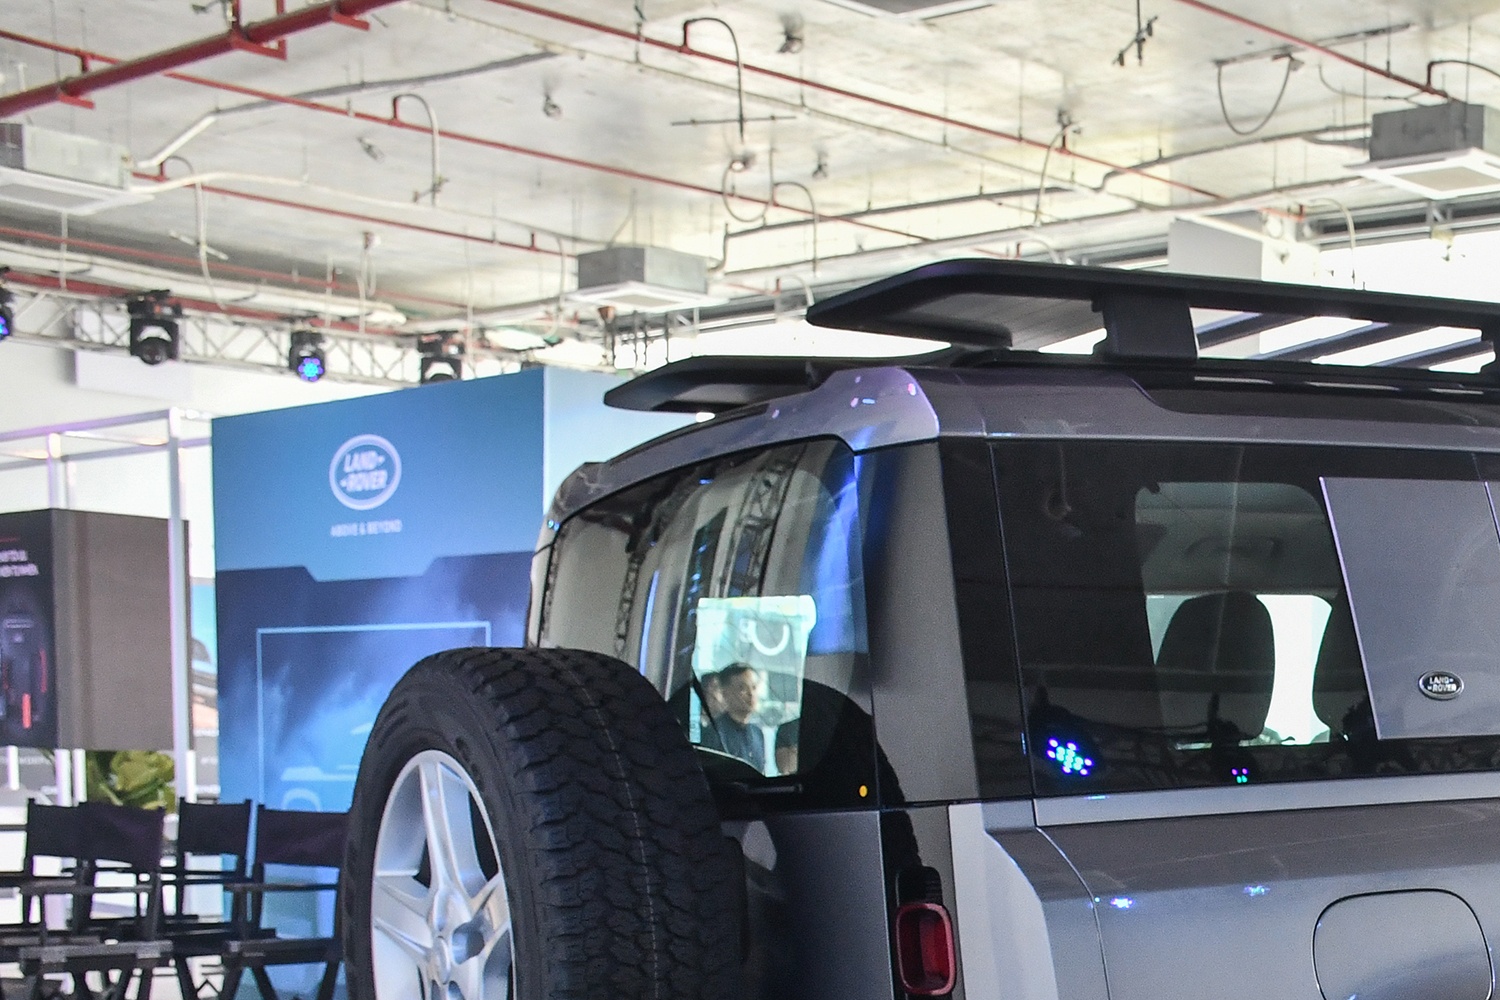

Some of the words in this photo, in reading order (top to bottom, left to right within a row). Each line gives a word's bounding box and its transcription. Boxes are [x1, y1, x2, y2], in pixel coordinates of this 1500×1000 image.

[343, 450, 379, 473] LAND
[346, 469, 388, 492] ROVER
[1429, 676, 1449, 684] LAND
